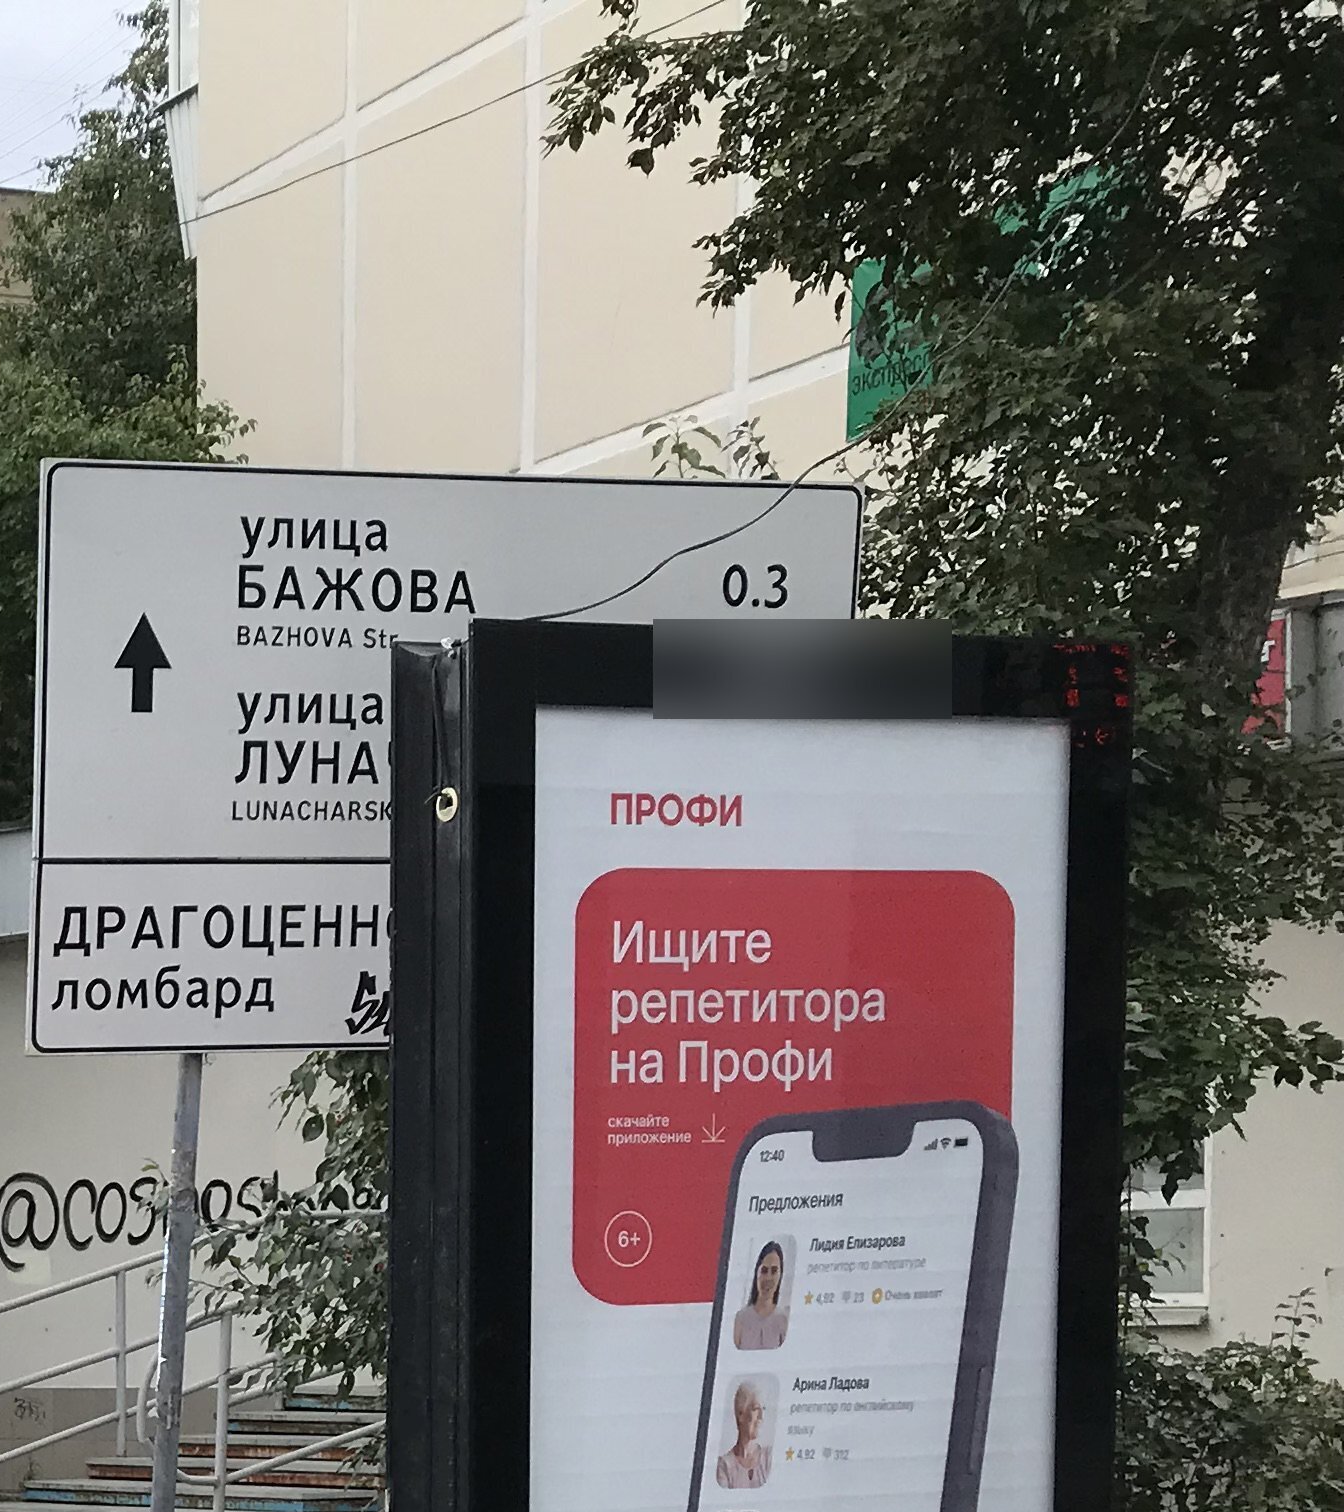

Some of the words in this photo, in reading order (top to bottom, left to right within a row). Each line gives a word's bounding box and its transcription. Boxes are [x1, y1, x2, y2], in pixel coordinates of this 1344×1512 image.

[240, 515, 389, 559] улица
[237, 565, 477, 616] БАЖОВА
[722, 564, 790, 609] 0.3
[237, 625, 353, 648] BAZHOVA
[237, 692, 384, 735] улица
[234, 740, 392, 785] ЛУНА
[610, 793, 744, 827] ПРОФИ
[53, 904, 391, 957] ДРАГОЦЕНН
[612, 920, 772, 971] Ищите
[51, 964, 275, 1019] ломбард
[611, 985, 887, 1034] репетитора
[610, 1049, 664, 1084] на
[678, 1039, 833, 1093] Профи
[607, 1114, 670, 1128] скачайте
[607, 1131, 692, 1147] приложение
[760, 1149, 785, 1163] 12:40
[748, 1193, 844, 1215] Предложения
[618, 1230, 641, 1248] 6+
[809, 1237, 845, 1252] Лидия
[846, 1235, 906, 1251] Елизарова
[792, 1377, 827, 1393] Арина
[828, 1376, 870, 1392] Ладова
